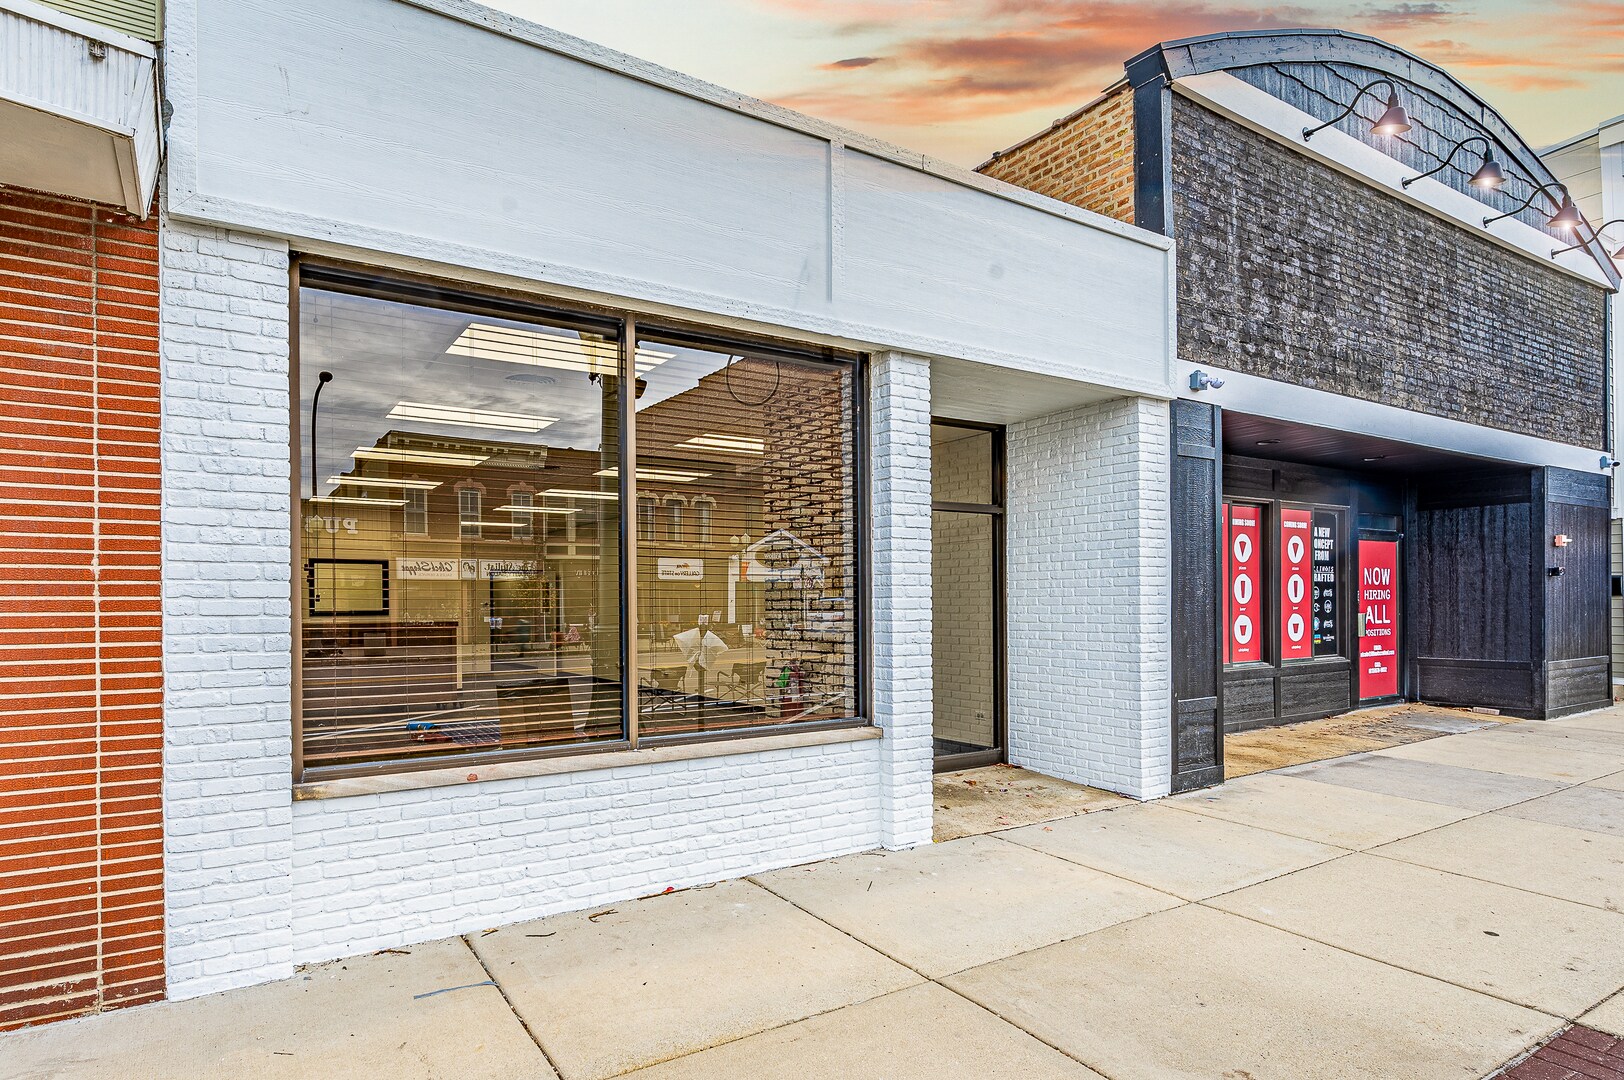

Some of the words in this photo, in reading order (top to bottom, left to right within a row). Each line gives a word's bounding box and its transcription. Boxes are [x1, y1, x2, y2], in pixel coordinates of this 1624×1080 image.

[1314, 527, 1318, 537] A
[1319, 527, 1330, 538] NEW
[1314, 539, 1333, 549] ONCEPT
[1315, 550, 1329, 560] FROM
[1314, 574, 1334, 582] RAFTED
[1364, 567, 1390, 586] NOW
[1364, 589, 1391, 600] HIRING
[1365, 604, 1391, 624] ALL
